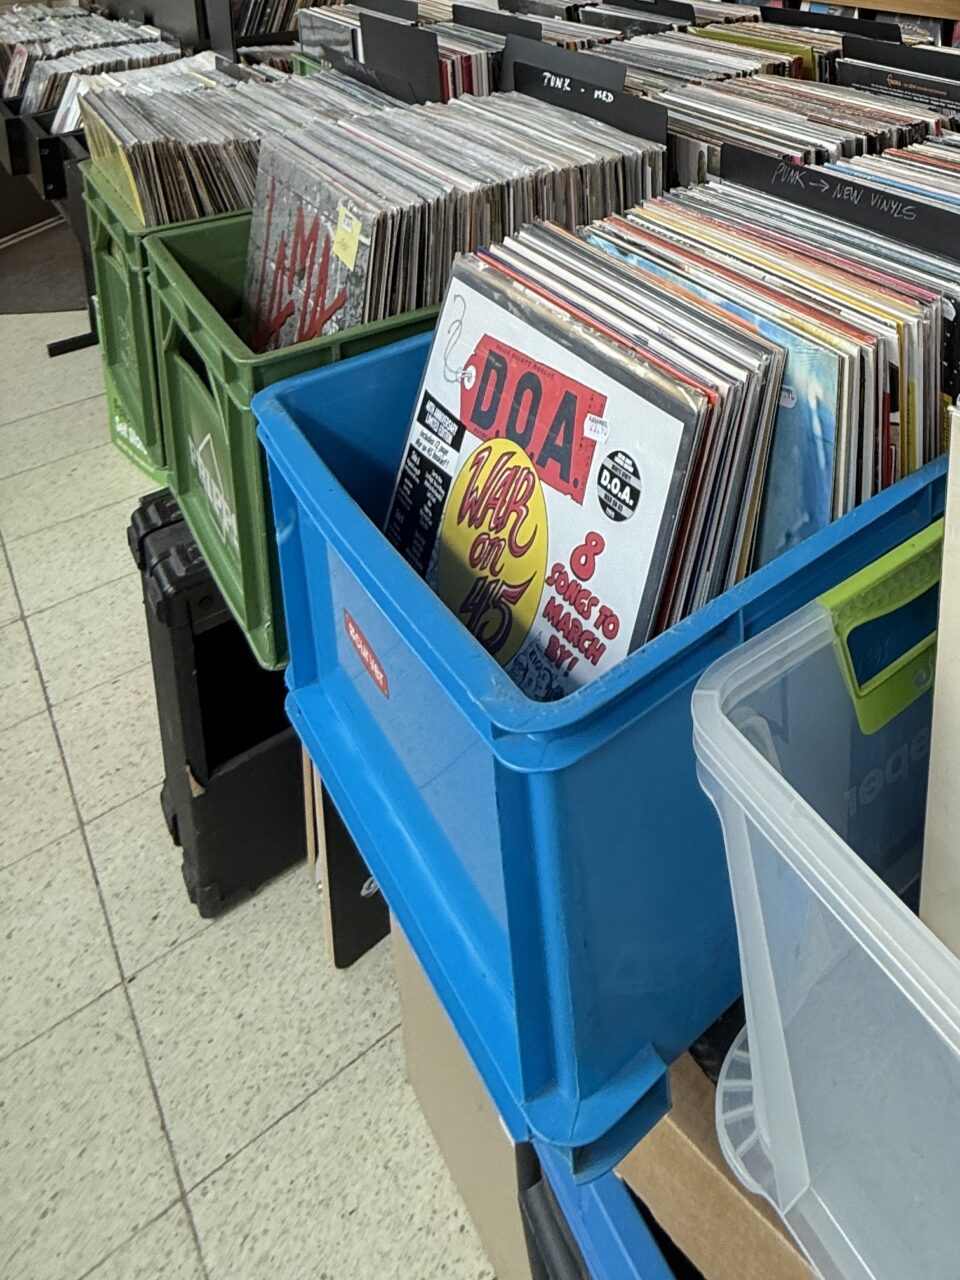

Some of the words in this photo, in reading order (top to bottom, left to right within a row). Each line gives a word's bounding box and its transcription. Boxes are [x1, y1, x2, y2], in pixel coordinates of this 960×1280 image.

[542, 71, 572, 91] PUNK
[771, 161, 805, 190] PUNK
[832, 183, 862, 206] NEW
[470, 348, 580, 489] D.O.A.
[456, 445, 539, 559] WAR
[600, 468, 634, 507] D.O.A.
[468, 531, 505, 577] on
[570, 531, 605, 582] 8
[458, 570, 538, 658] 45
[545, 563, 599, 620] SONGS
[594, 605, 620, 640] TO
[542, 596, 607, 666] MARCH
[544, 634, 579, 678] BY!
